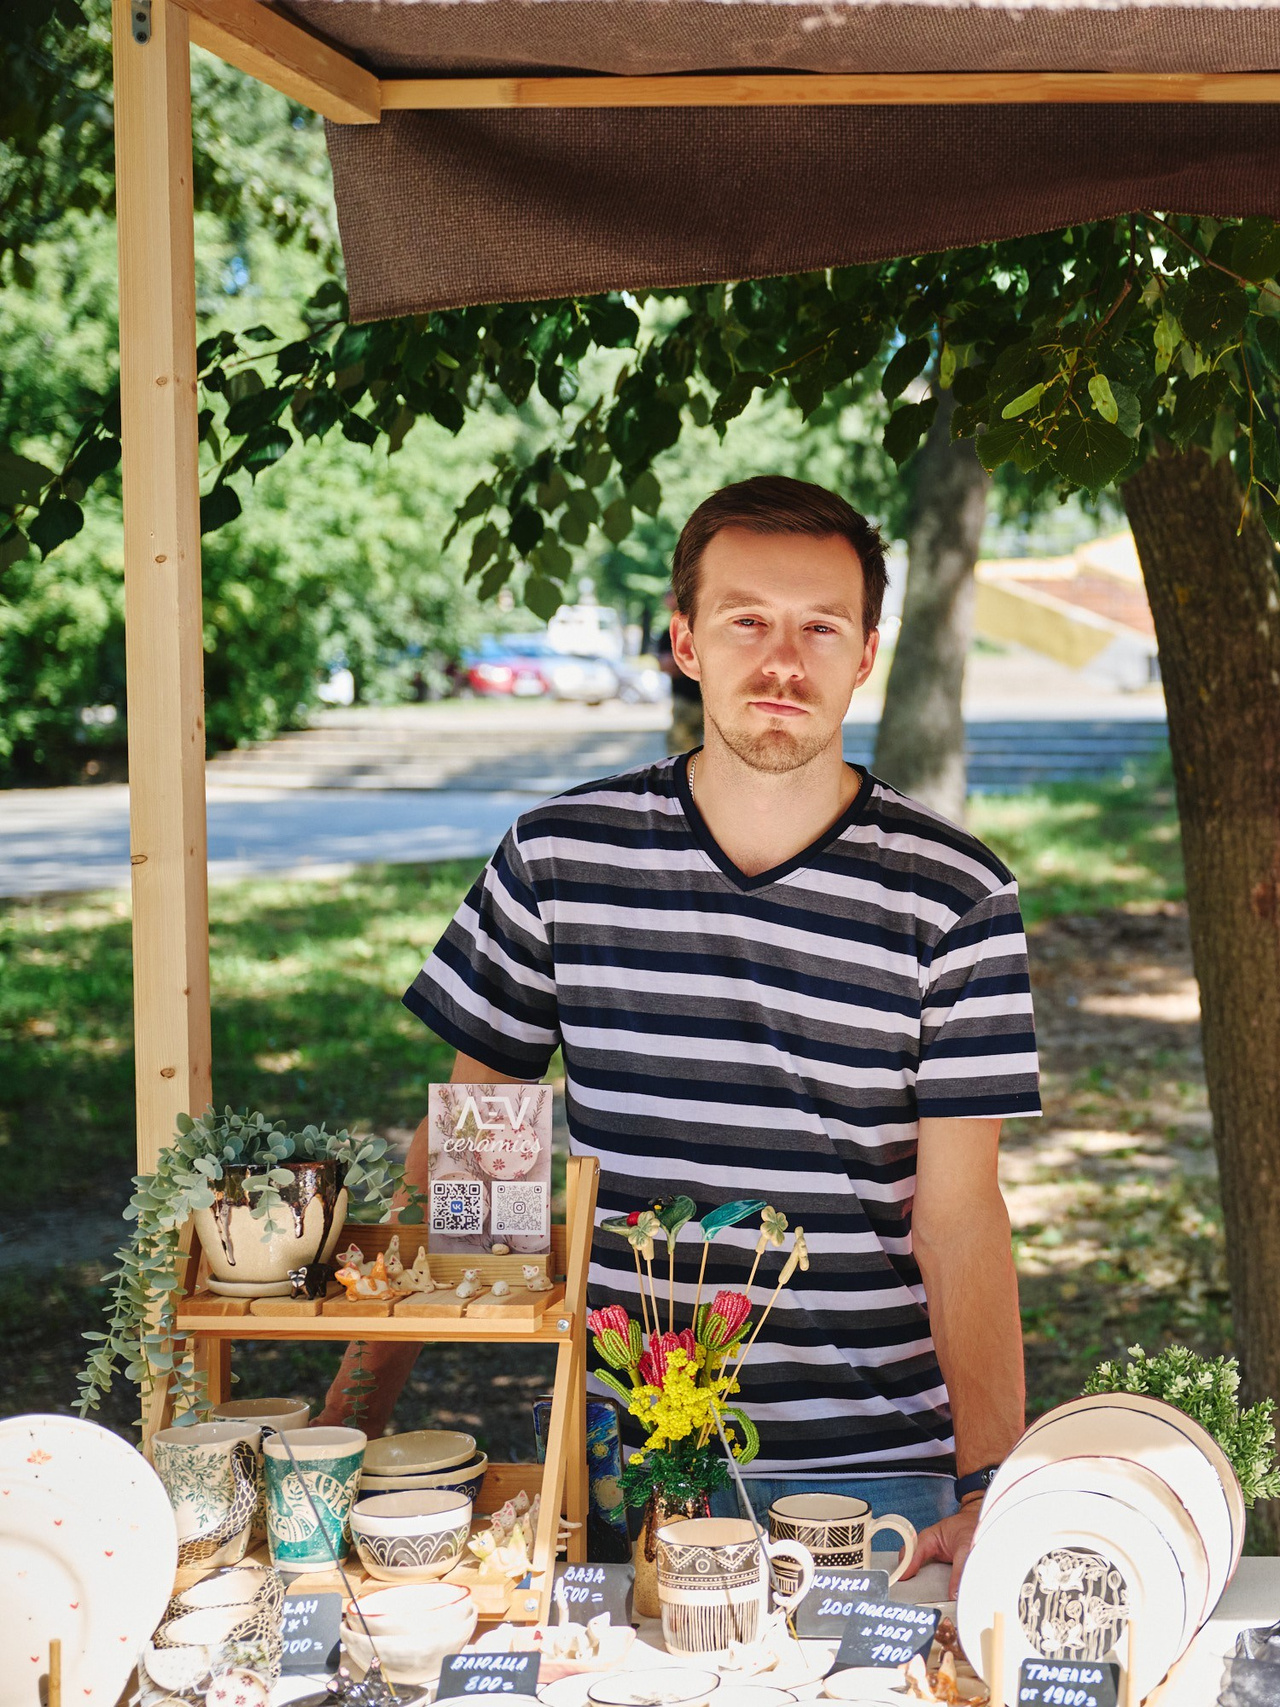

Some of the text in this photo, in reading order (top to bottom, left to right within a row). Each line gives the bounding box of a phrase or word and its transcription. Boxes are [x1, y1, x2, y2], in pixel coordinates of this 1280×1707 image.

[443, 1133, 543, 1153] ceramics
[563, 1566, 606, 1584] ВАЗА
[811, 1574, 870, 1591] КРУЖКА
[282, 1599, 319, 1615] КАН
[854, 1601, 937, 1625] ПОДСТАВКА
[450, 1655, 529, 1672] БЛЮДЦА
[1025, 1663, 1104, 1684] ТАРЕЛКА
